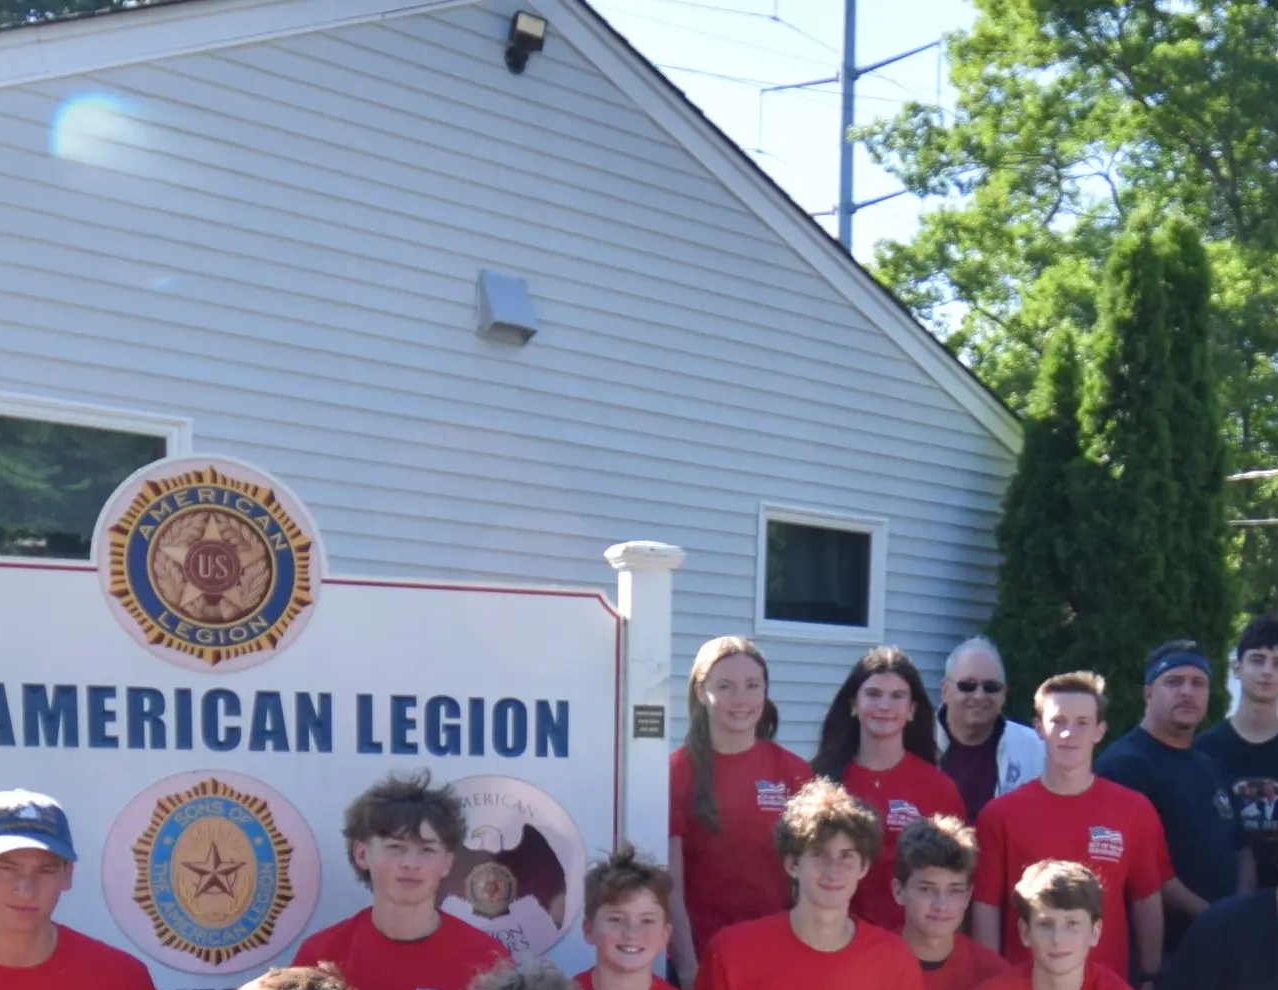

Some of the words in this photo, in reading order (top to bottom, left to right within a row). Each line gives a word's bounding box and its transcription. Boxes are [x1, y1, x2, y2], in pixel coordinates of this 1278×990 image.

[139, 487, 288, 551] AMERICAN
[157, 611, 269, 644] LEGION
[357, 693, 570, 758] LEGION
[174, 801, 223, 826] SONS
[229, 807, 253, 825] OF
[459, 793, 538, 818] MERICAN
[153, 860, 169, 893] THE
[162, 901, 248, 945] AMERICAN
[249, 861, 273, 926] LEGION
